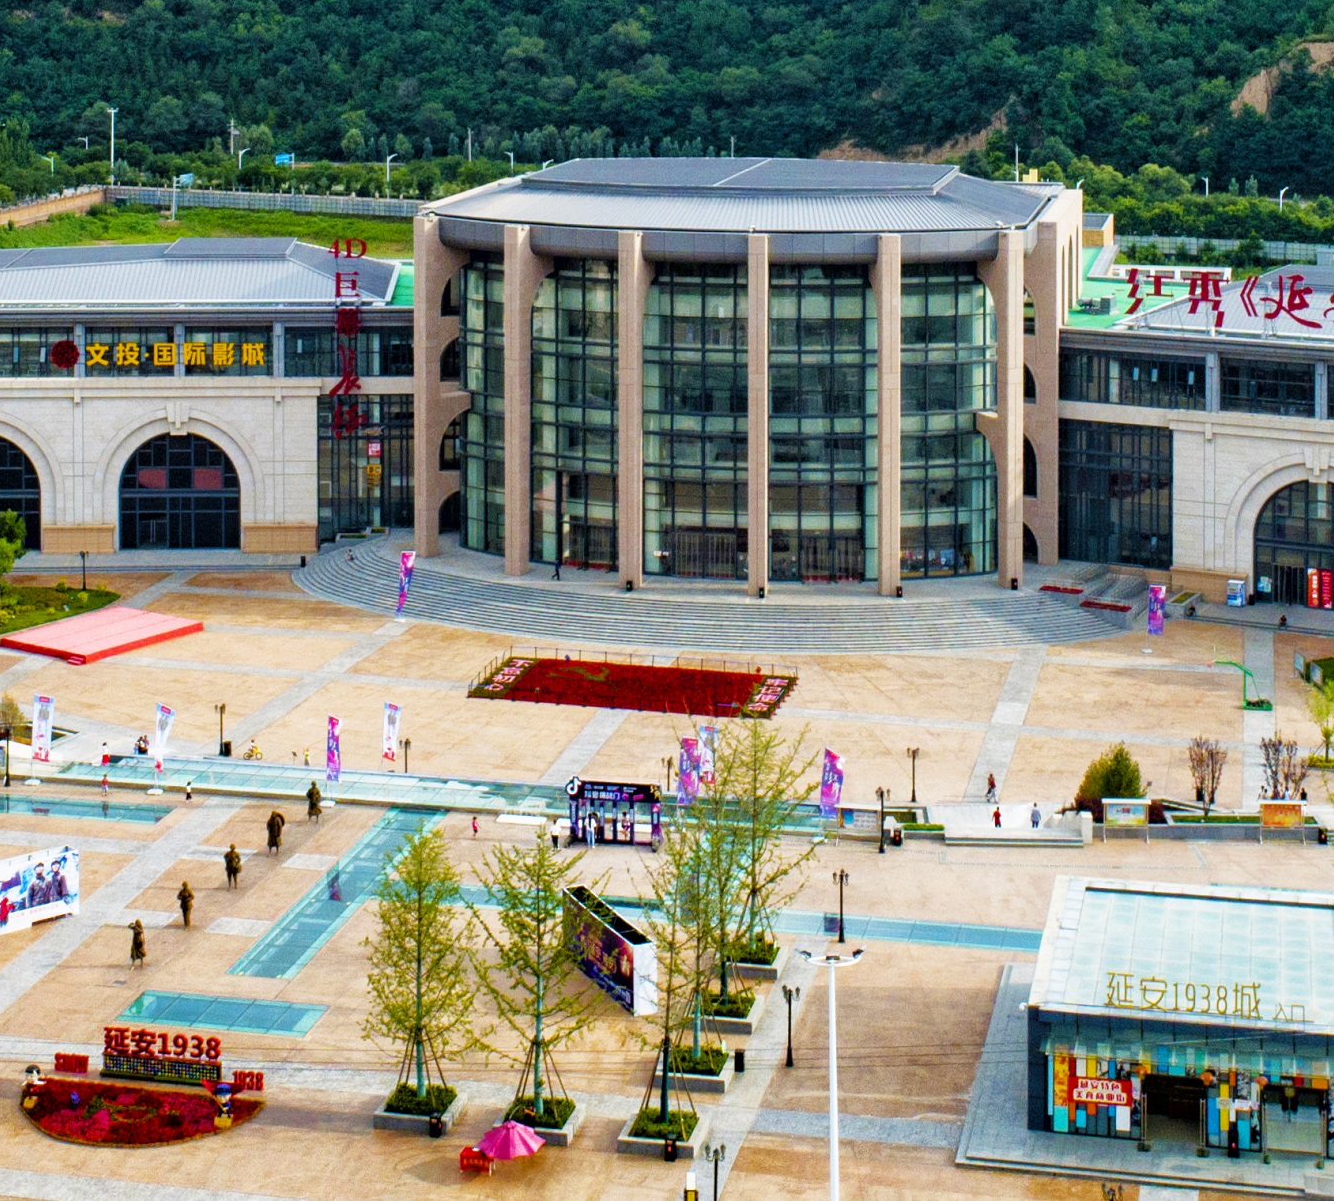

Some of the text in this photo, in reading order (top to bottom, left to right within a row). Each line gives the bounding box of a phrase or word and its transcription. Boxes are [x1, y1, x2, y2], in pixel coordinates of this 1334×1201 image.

[85, 342, 266, 367] 文投·国际影城
[484, 659, 534, 691] 不忘初心
[1103, 971, 1263, 1020] 延安1938城
[103, 1026, 222, 1060] 延安1938
